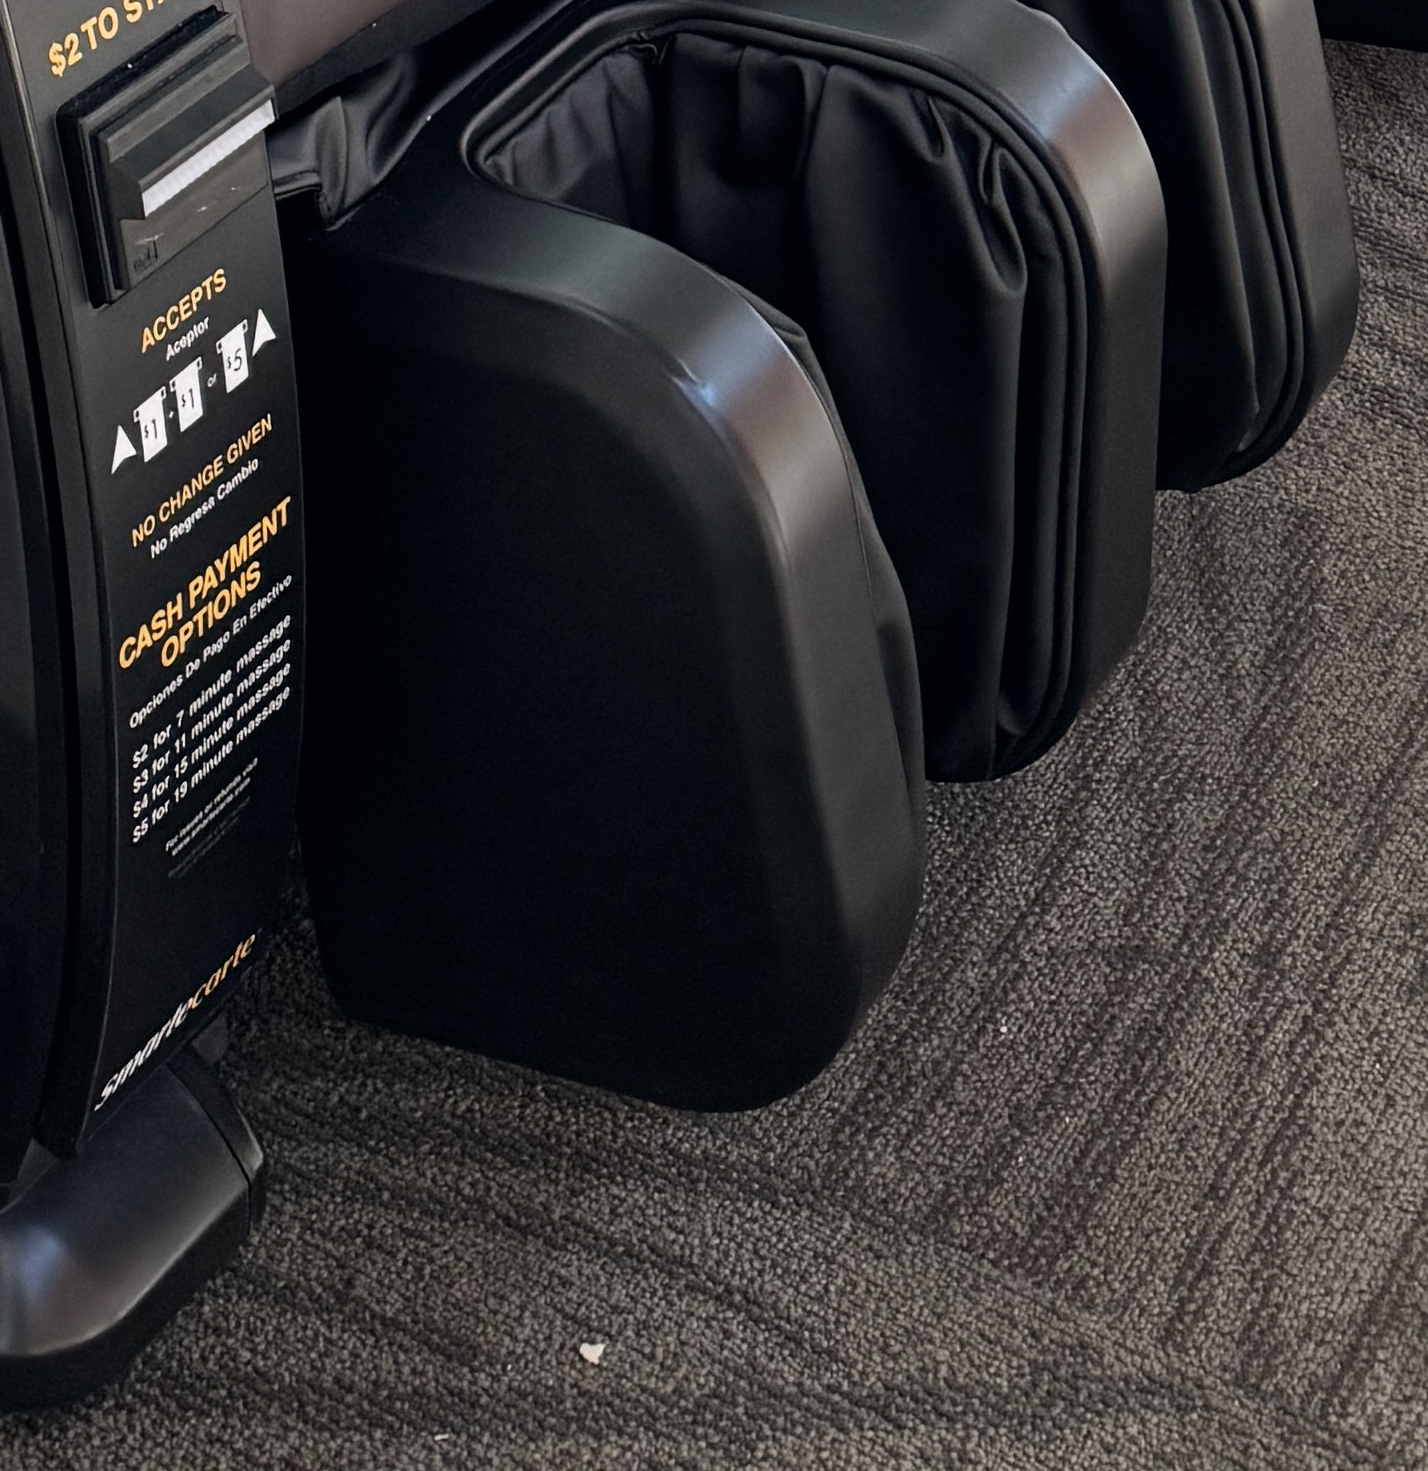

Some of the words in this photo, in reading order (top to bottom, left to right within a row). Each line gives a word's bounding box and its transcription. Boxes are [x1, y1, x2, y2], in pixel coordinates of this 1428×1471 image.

[48, 33, 83, 77] $2
[80, 6, 119, 51] TO
[140, 268, 227, 354] ACCEPTS
[166, 316, 210, 361] Aceptor
[131, 515, 156, 547] NO
[159, 454, 223, 522] CHANGE
[227, 413, 272, 465] GIVEN
[150, 538, 168, 559] No
[169, 496, 215, 542] Regresa
[217, 458, 259, 501] Cambio
[119, 592, 183, 669] CASH
[188, 496, 291, 609] PAYMENT
[129, 674, 183, 729] Opciones
[185, 659, 201, 679] De
[203, 631, 230, 662] Pago
[232, 615, 247, 635] En
[249, 575, 292, 620] Efectivo
[161, 560, 261, 668] OPTIONS
[133, 744, 148, 769] $2
[153, 724, 172, 750] for
[176, 710, 185, 728] 7
[189, 669, 232, 717] minute
[236, 615, 291, 673] massage
[133, 769, 149, 794] $3
[152, 751, 170, 776] for
[174, 733, 186, 753] 11
[191, 693, 233, 739] minute
[236, 639, 291, 697] massage
[133, 793, 149, 818] $4
[151, 775, 170, 801] for
[174, 756, 188, 778] 15
[191, 717, 233, 764] minute
[236, 663, 291, 721] massage
[133, 817, 149, 843] $5
[151, 799, 170, 825] for
[174, 781, 188, 802] 19
[190, 740, 233, 788] minute
[236, 687, 290, 745] massage
